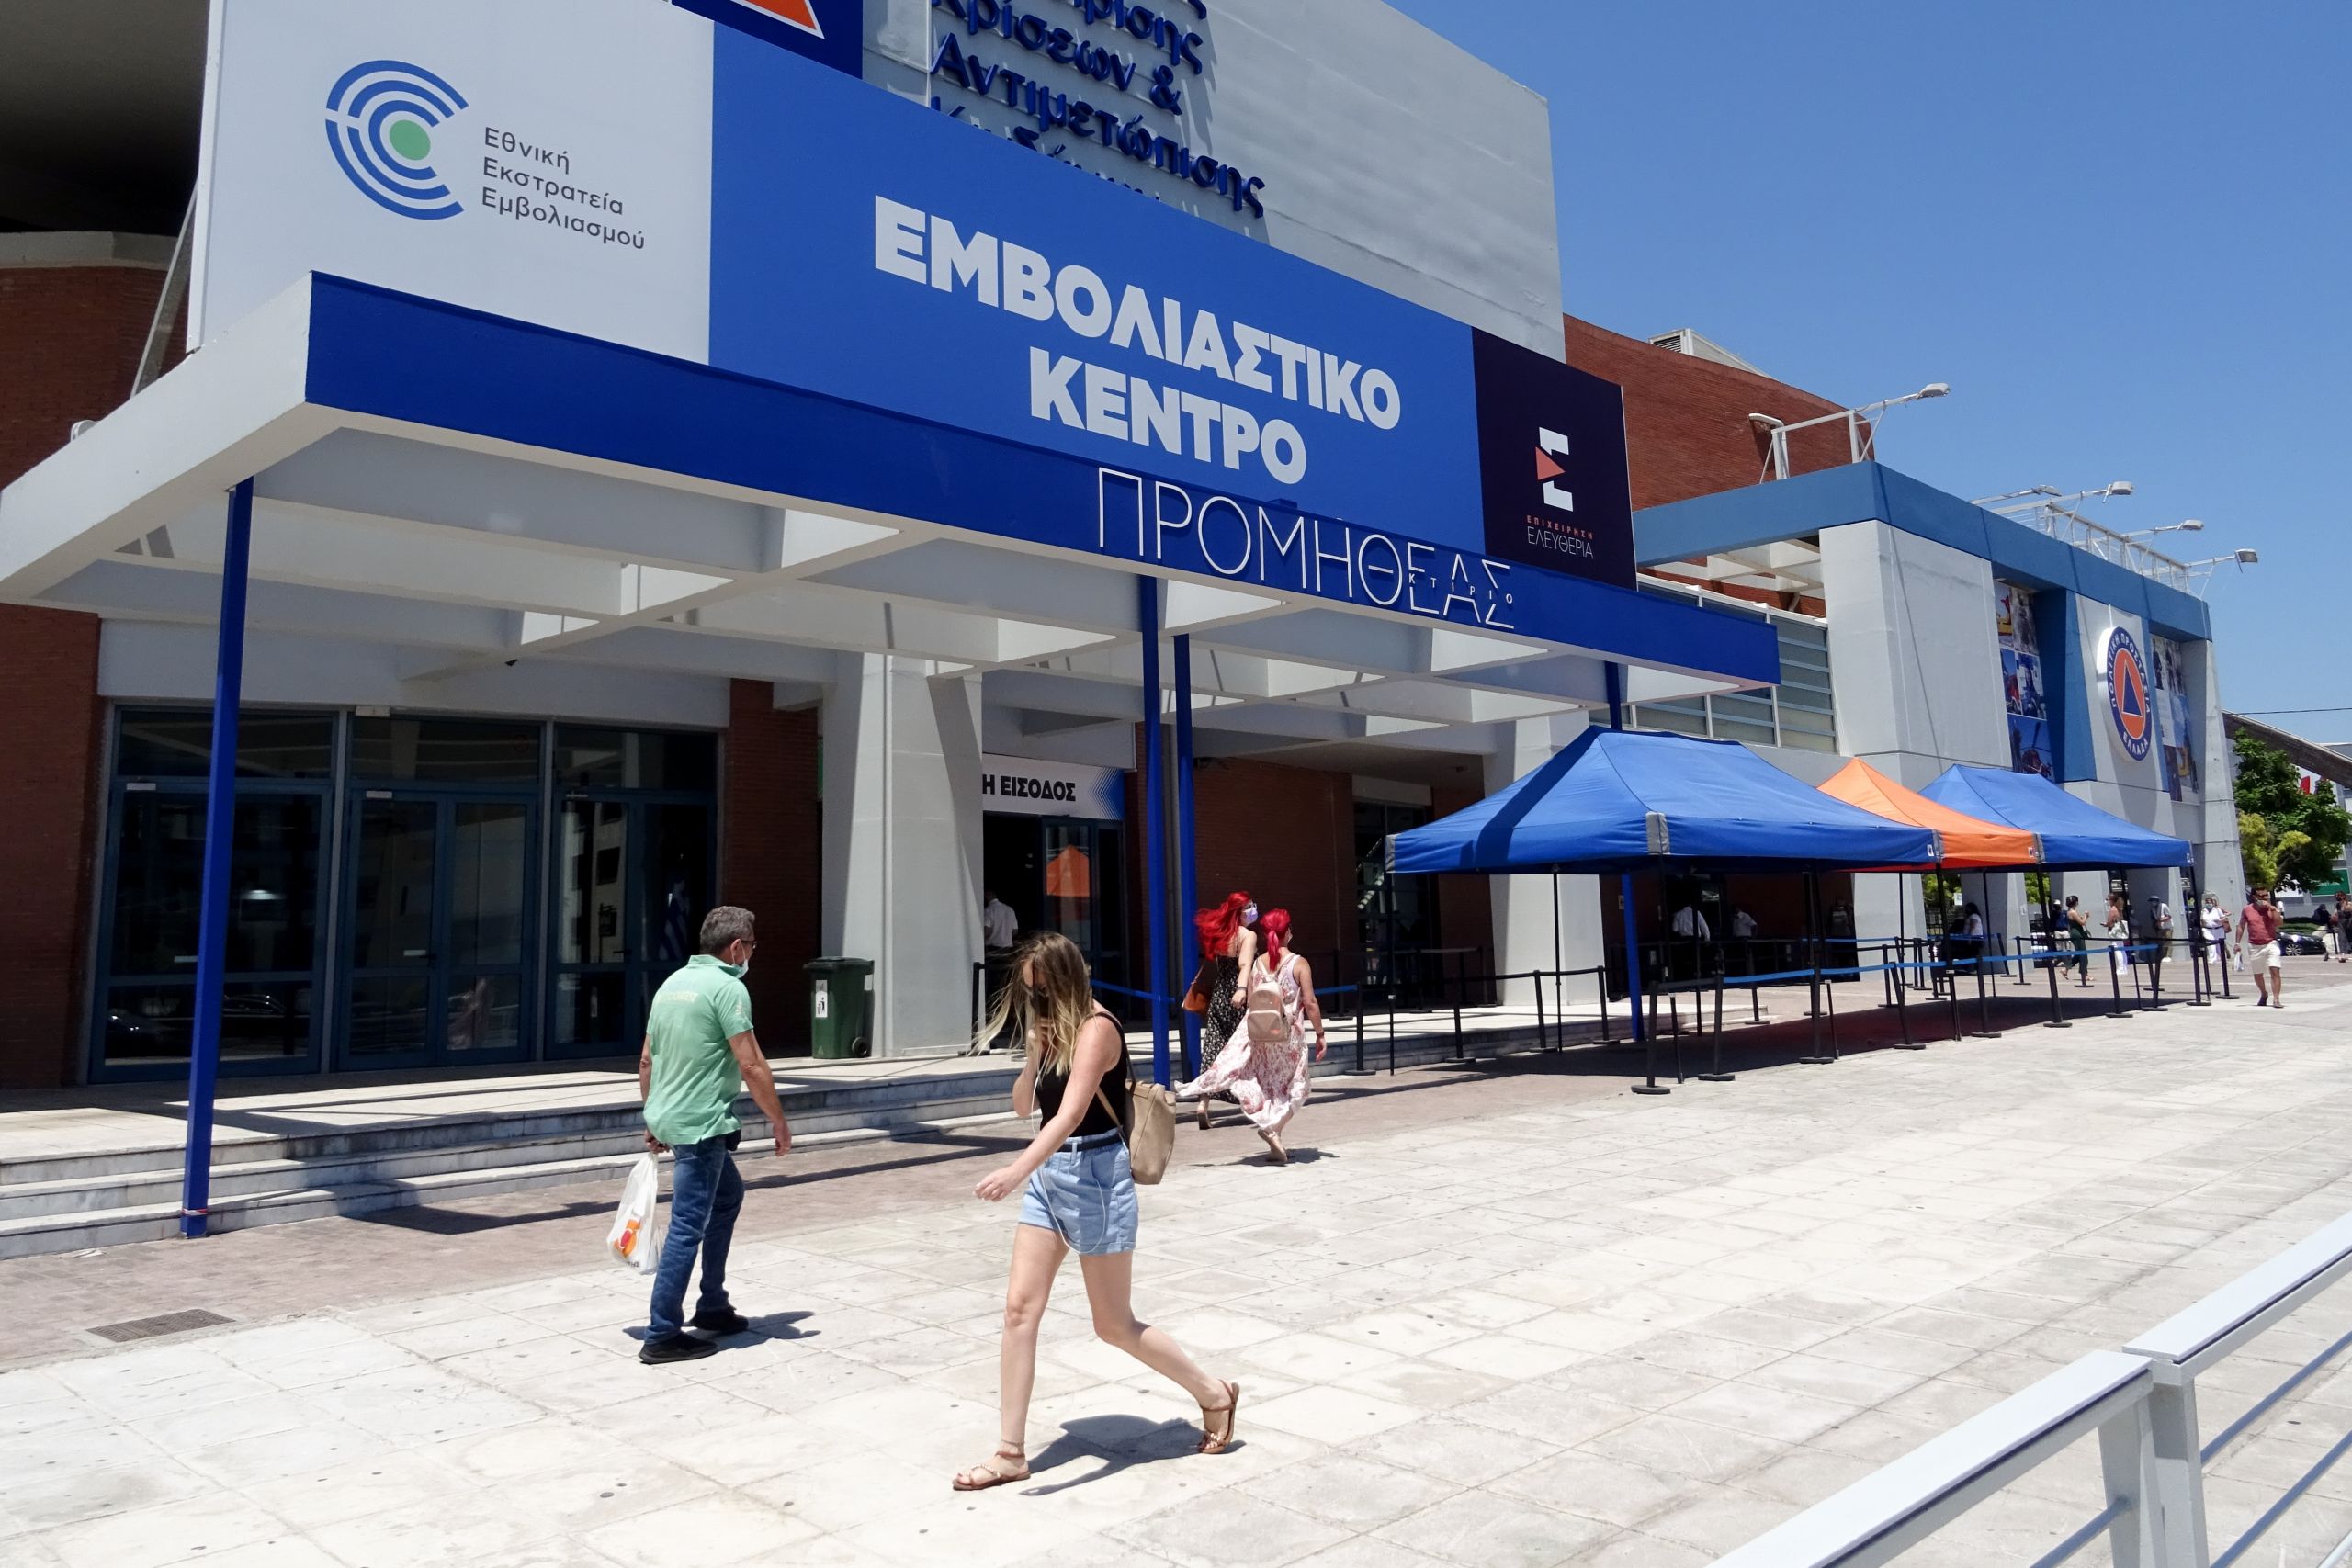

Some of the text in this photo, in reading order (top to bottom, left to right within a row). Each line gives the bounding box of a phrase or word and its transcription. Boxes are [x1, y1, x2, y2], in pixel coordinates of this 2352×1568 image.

[932, 0, 1182, 116] ρίσεων &
[483, 127, 571, 175] Εθνική
[930, 33, 1265, 218] Αντιμετώπισης
[482, 157, 624, 215] Εκστρατεία
[481, 186, 645, 250] Εμβολιασμού
[875, 195, 1400, 430] ΕΜΒΟΛΙΑΣΤΙΚΟ
[1030, 346, 1306, 484] ΚΕΝΤΡΟ
[1099, 467, 1514, 629] ΠΡΟΜΗΘΕΑΣ
[1526, 514, 1593, 540] ΕΠΙΧΕΙΡΗΣΗ
[1527, 525, 1594, 559] ΕΛΕΥΘΕΡΙΑ
[2123, 731, 2148, 755] ΕΛΛΑΔΑ
[1000, 775, 1076, 802] ΕΙΣΟΔΟΣ
